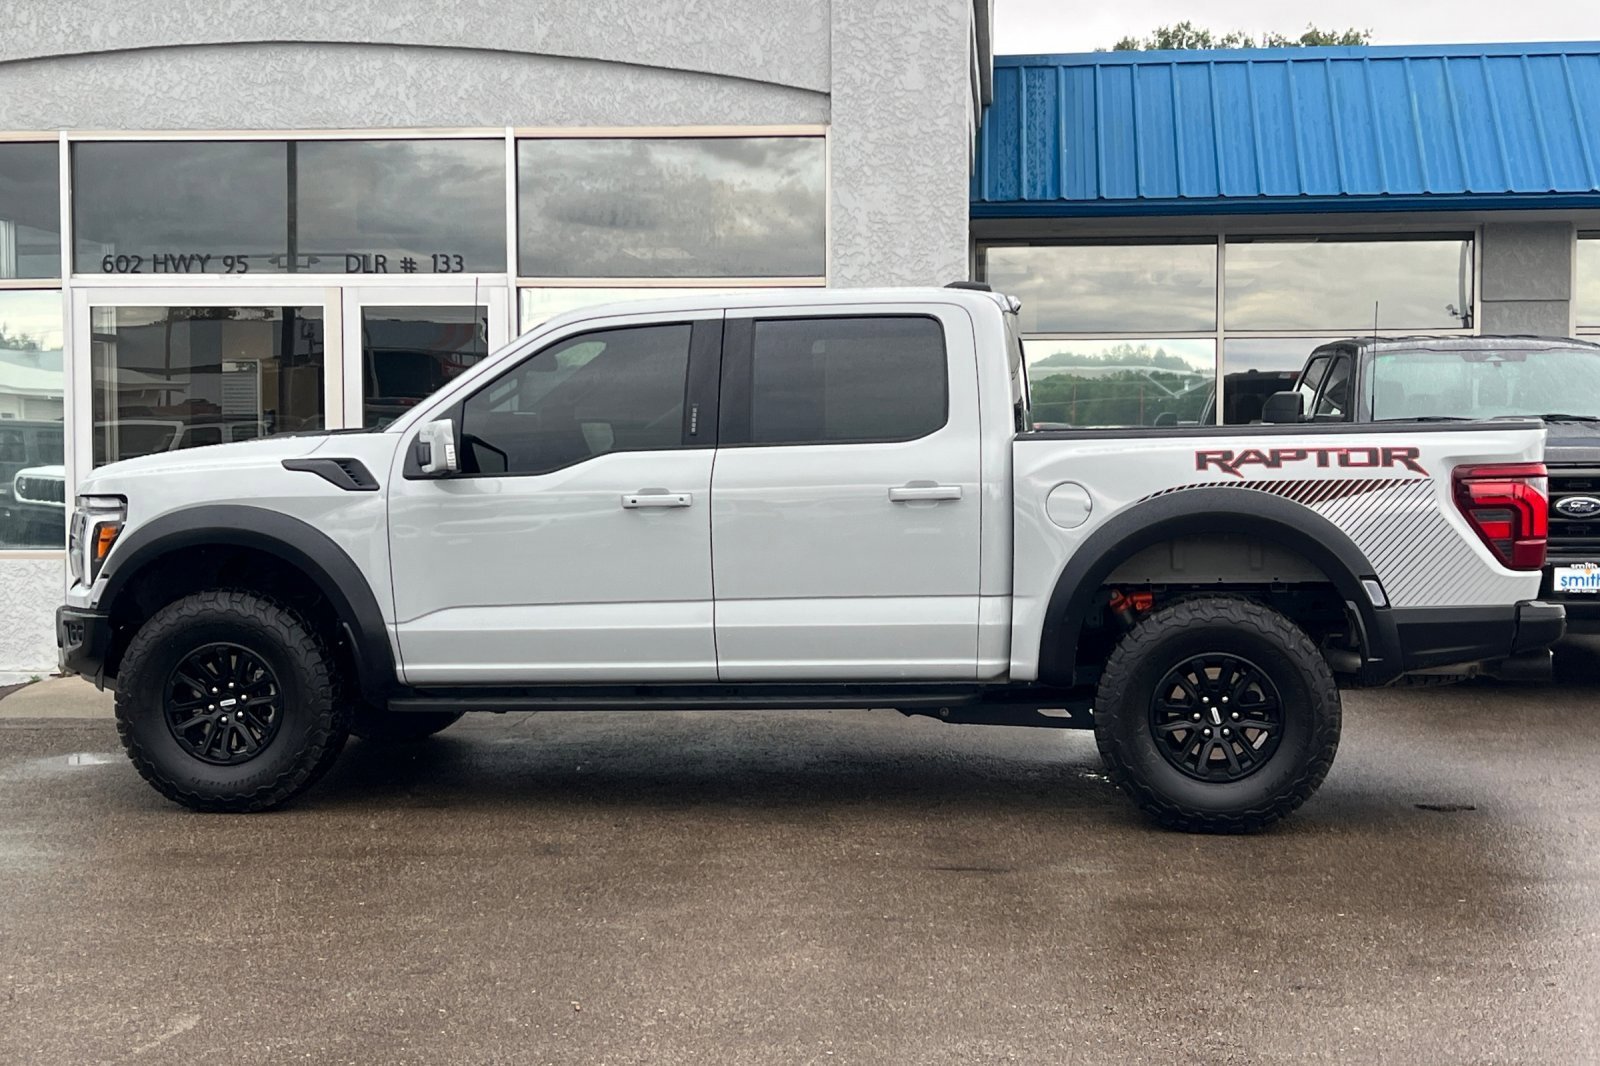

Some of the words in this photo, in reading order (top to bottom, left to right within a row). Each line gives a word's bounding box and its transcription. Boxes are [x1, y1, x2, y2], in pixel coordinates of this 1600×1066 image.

[102, 254, 141, 273] 602
[153, 253, 211, 273] HWY
[223, 254, 249, 273] 95
[345, 254, 387, 273] DLR
[400, 257, 417, 273] #
[431, 253, 464, 273] 133
[1195, 446, 1430, 478] RAPTOR
[1568, 501, 1596, 512] Ford
